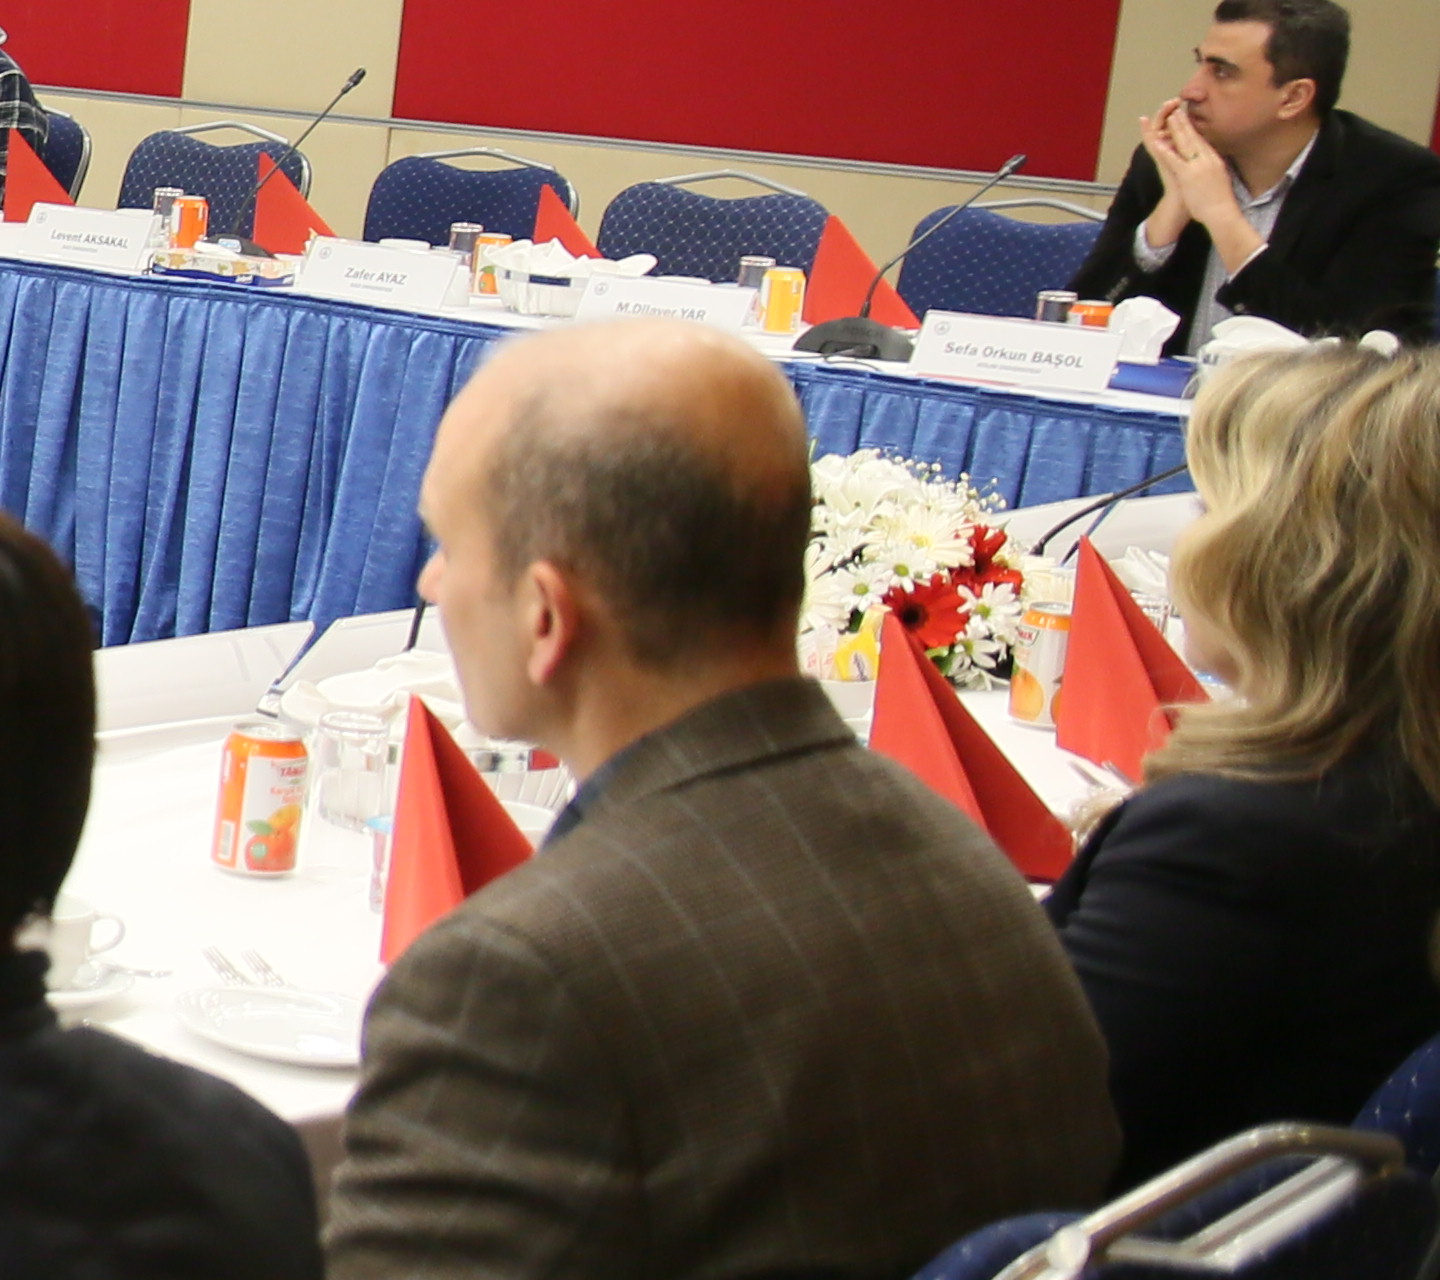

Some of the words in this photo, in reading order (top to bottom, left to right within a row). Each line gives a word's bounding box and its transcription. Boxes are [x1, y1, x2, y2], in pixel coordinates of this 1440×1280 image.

[51, 229, 82, 240] Levent
[83, 233, 129, 249] AKSAKAL
[345, 267, 376, 281] Zafer
[376, 272, 407, 285] AYAZ
[679, 307, 706, 321] YAR
[944, 341, 978, 356] Sefa
[982, 345, 1027, 361] Orkun
[1031, 351, 1085, 368] BAŞOL
